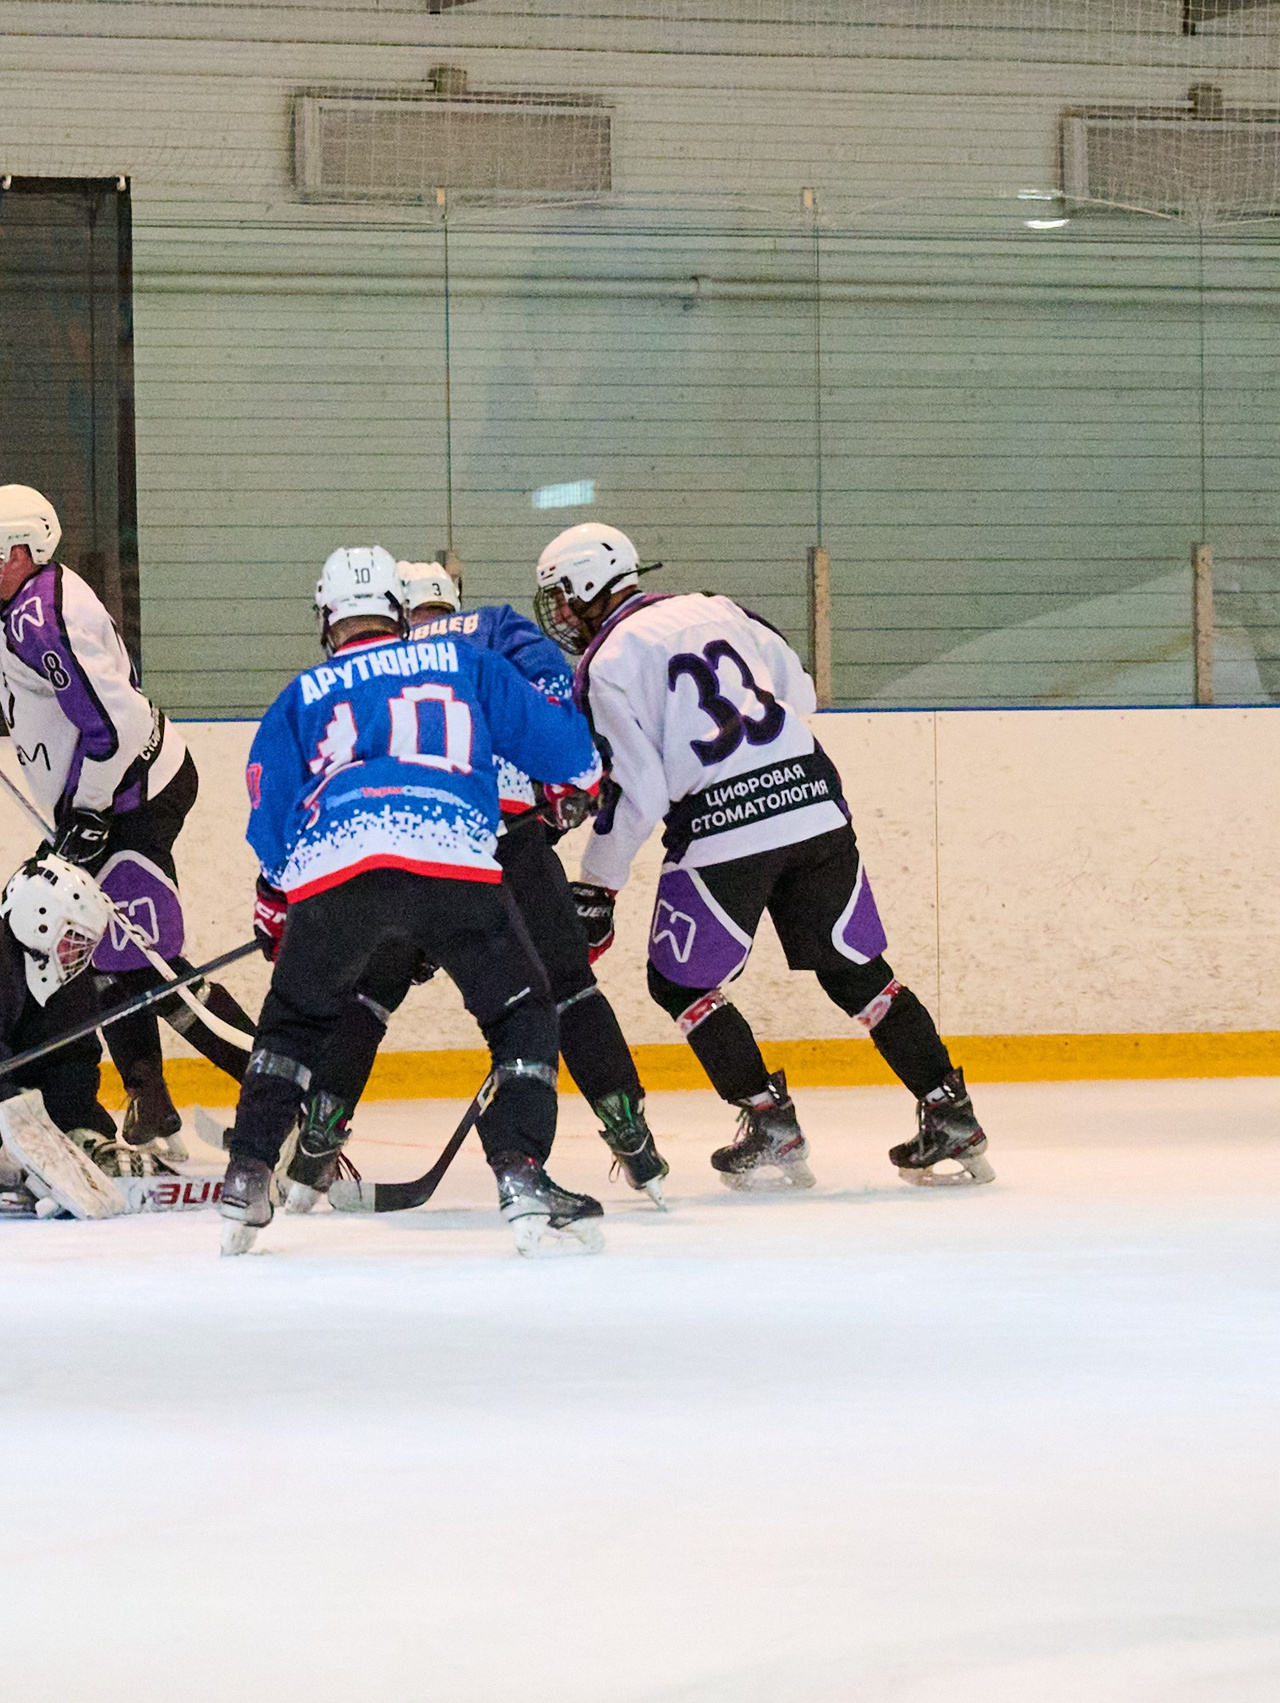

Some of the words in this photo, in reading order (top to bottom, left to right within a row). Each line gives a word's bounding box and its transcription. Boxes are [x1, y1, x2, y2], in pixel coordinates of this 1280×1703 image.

[354, 566, 371, 585] 10
[431, 582, 442, 597] 3
[41, 650, 72, 692] 8
[300, 641, 459, 706] АРУТЮНЯН
[668, 638, 786, 767] 33
[308, 682, 474, 776] 10
[690, 778, 830, 834] СТОМАТОЛОГИЯ
[705, 763, 806, 808] ЦИФРОВАЯ
